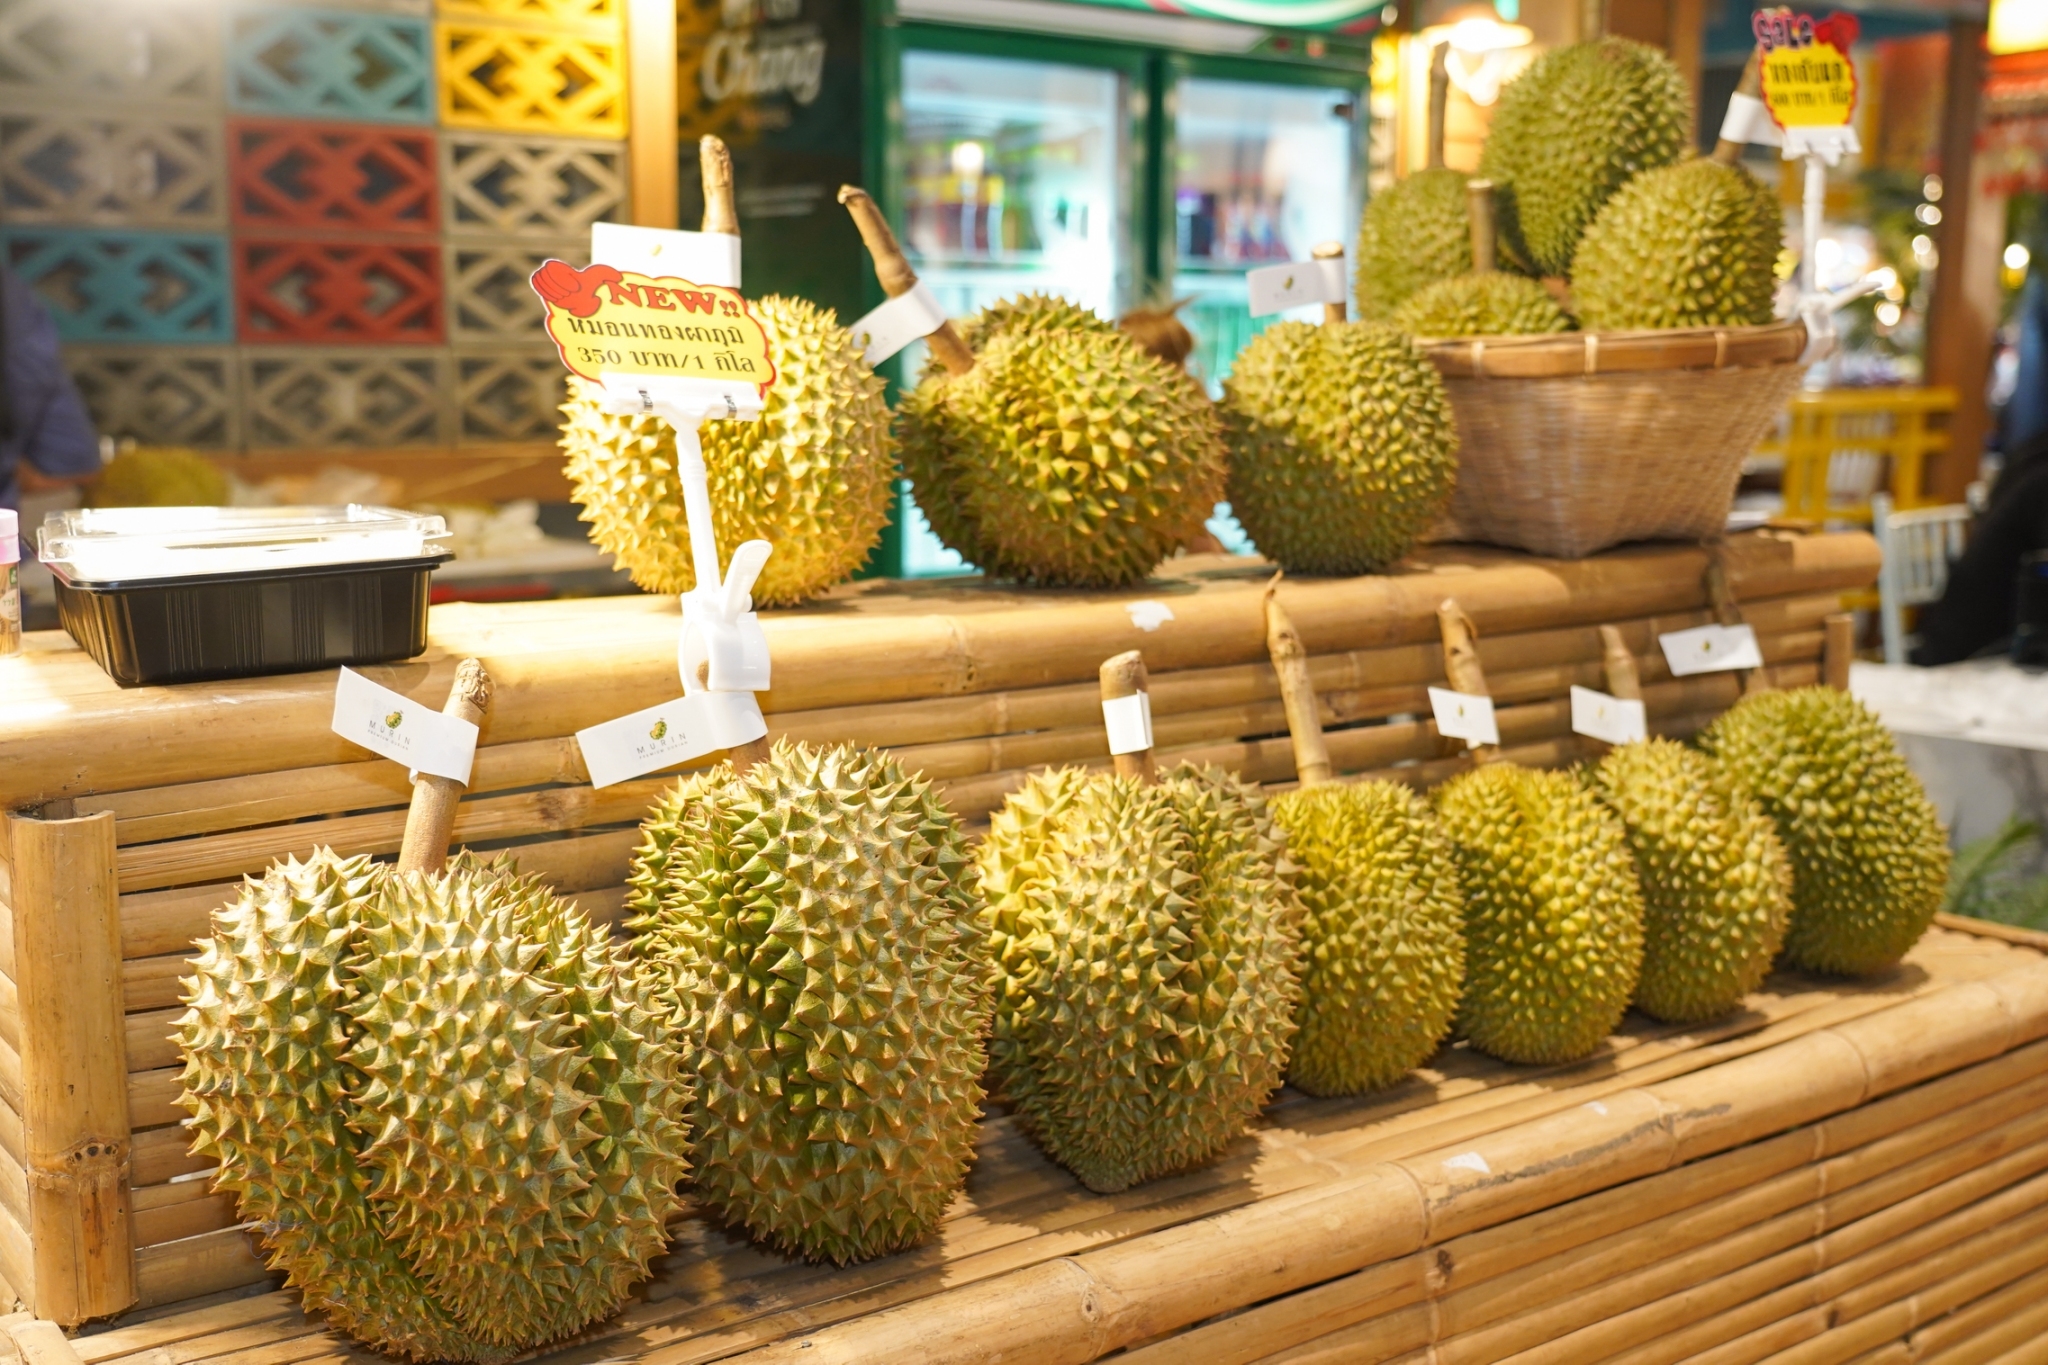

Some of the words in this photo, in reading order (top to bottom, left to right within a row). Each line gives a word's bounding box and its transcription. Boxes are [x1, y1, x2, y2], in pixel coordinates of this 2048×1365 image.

[701, 31, 827, 105] Chang
[577, 346, 622, 365] 350
[713, 350, 757, 373] กิโล
[369, 720, 411, 745] MURIN
[636, 732, 687, 754] MURIN
[639, 748, 665, 760] PREMIUM
